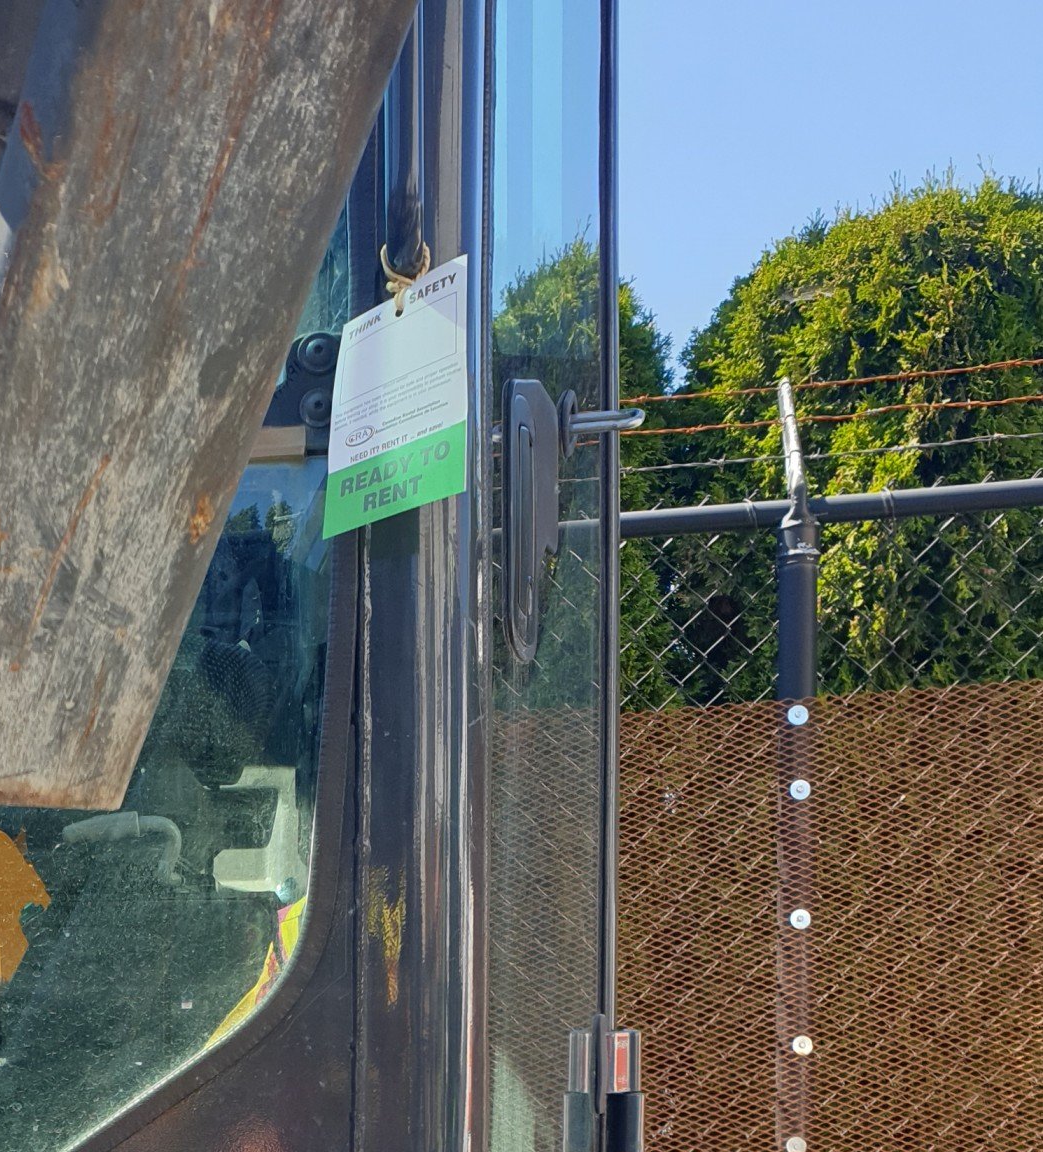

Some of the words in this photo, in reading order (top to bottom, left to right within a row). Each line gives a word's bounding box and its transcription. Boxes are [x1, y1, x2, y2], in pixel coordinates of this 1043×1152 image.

[348, 312, 383, 340] THINK
[409, 273, 458, 304] SAFETY
[340, 455, 414, 497] READY
[420, 440, 451, 467] TO
[350, 450, 369, 463] NEED
[369, 445, 381, 456] IT?
[381, 438, 401, 451] RENT
[400, 434, 410, 443] IT
[363, 474, 423, 513] RENT
